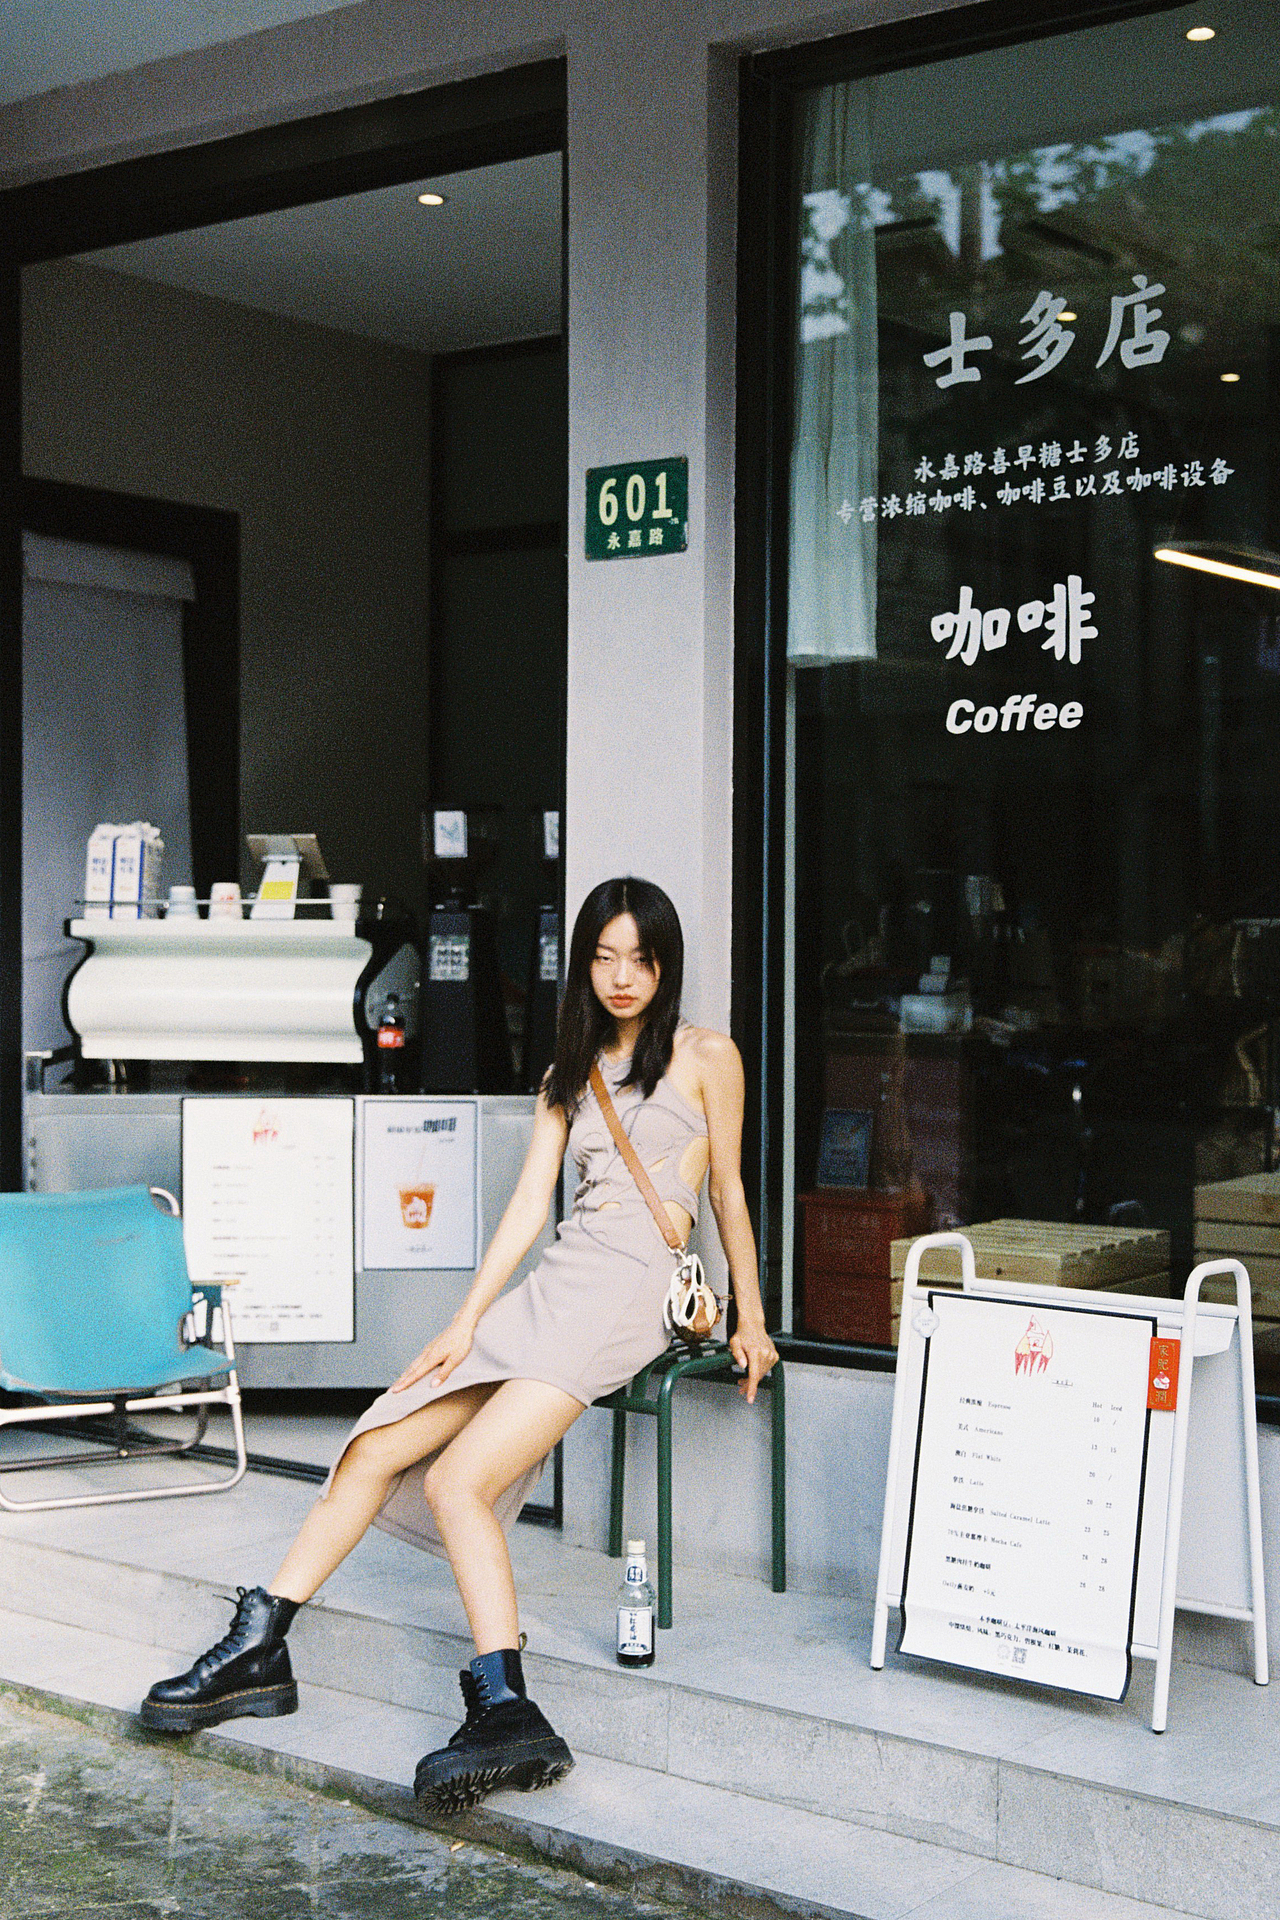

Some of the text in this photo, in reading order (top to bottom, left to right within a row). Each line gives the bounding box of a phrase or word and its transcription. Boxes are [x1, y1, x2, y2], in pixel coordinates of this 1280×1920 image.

[923, 274, 1171, 390] 士多店
[914, 431, 1140, 483] 永嘉路喜早糖士多店
[599, 471, 673, 526] 601
[607, 527, 664, 550] 永嘉路
[930, 574, 1099, 666] 咖啡
[945, 693, 1084, 735] Coffee
